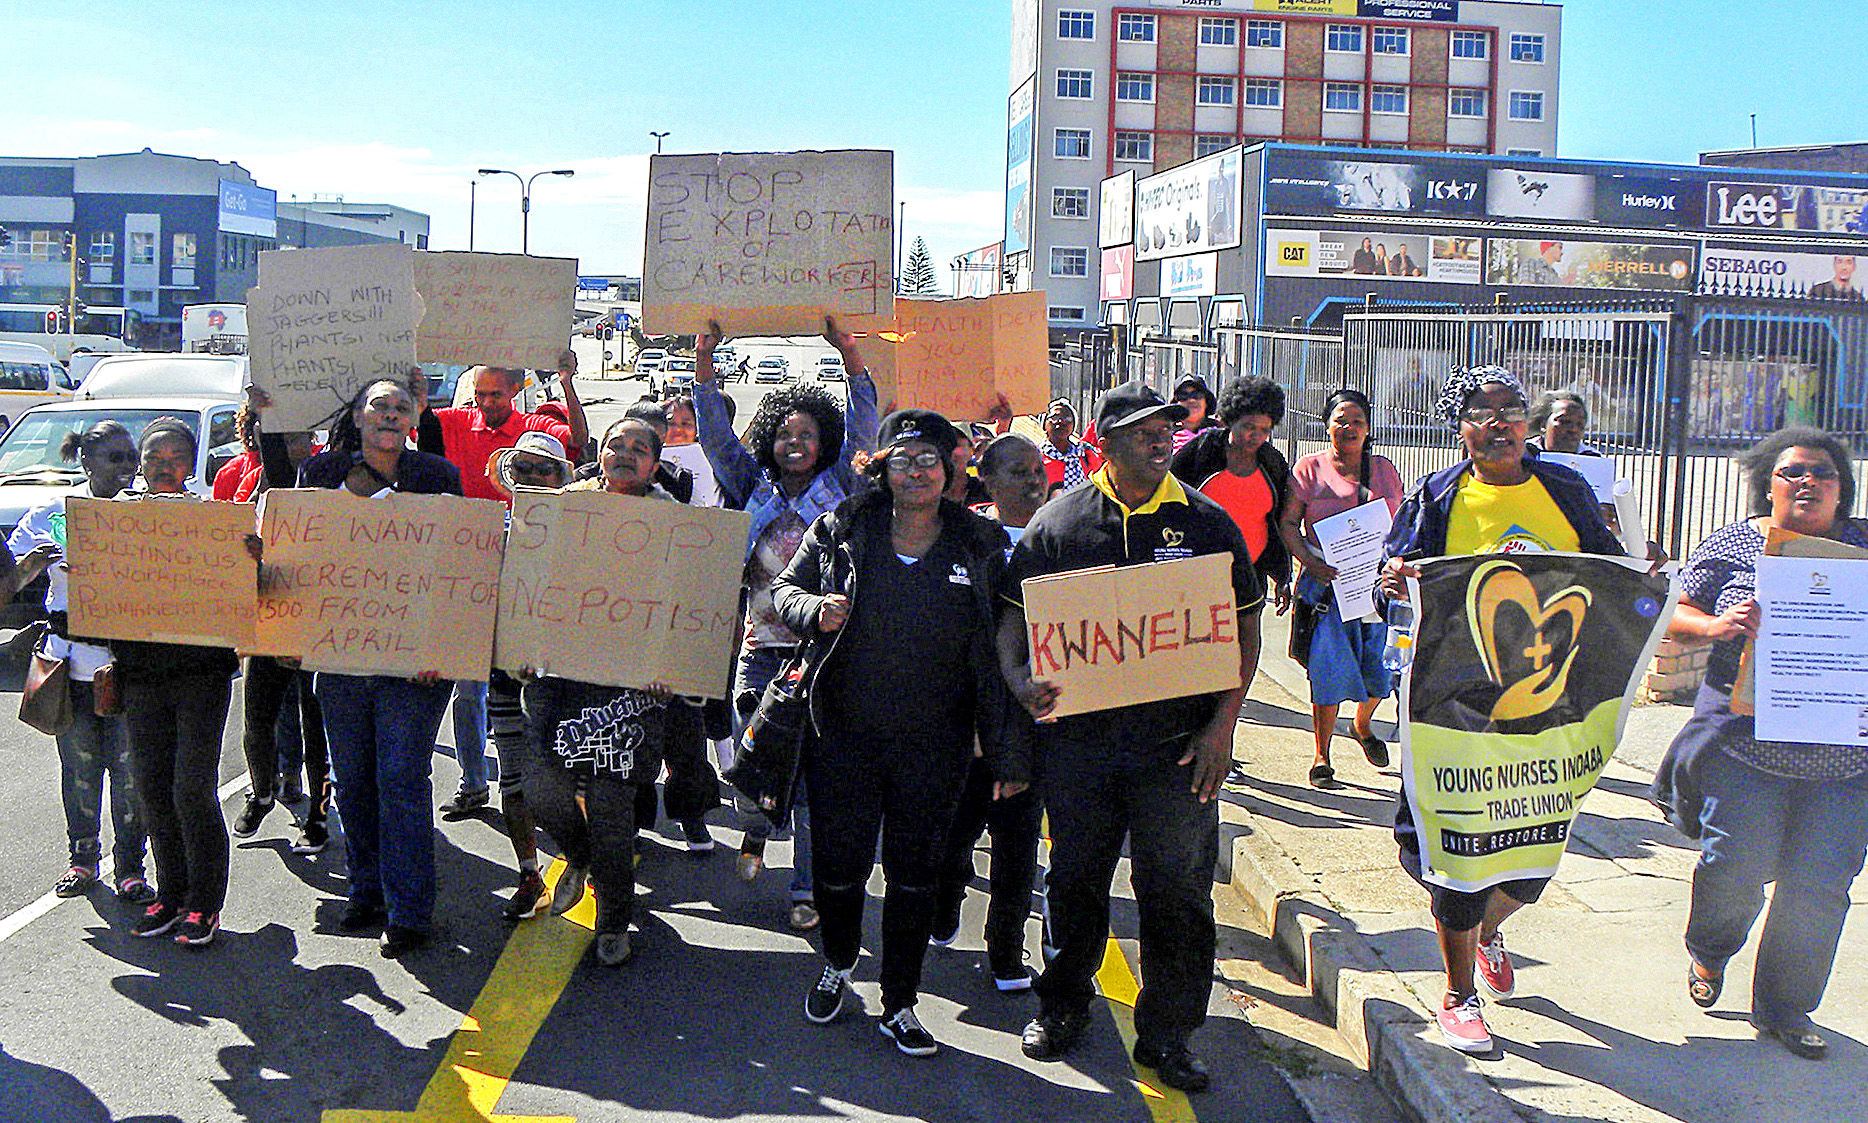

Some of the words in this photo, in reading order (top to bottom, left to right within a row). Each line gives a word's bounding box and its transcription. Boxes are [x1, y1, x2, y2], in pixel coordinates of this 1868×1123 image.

[1364, 0, 1452, 10] PROFESSIONAL
[1383, 8, 1432, 18] SERVICE
[654, 171, 803, 205] STOP
[1622, 193, 1663, 209] Hurley
[1717, 187, 1778, 226] Lee
[1283, 247, 1305, 261] CAT
[1705, 256, 1788, 276] SEBAGO
[351, 286, 392, 304] WITH
[73, 506, 199, 538] ENOUGH
[270, 506, 326, 547] WE
[350, 516, 437, 544] WANT
[454, 527, 503, 554] OUR
[520, 503, 714, 563] STOP
[319, 596, 409, 621] FROM
[511, 576, 735, 641] NEPOTISM
[312, 627, 415, 653] APRIL
[1031, 601, 1235, 677] KWANELE
[1433, 766, 1493, 794] YOUNG
[1497, 759, 1558, 789] NURSES
[1562, 745, 1604, 782] INDABA
[1486, 797, 1529, 821] TRADE
[1531, 791, 1573, 816] UNION
